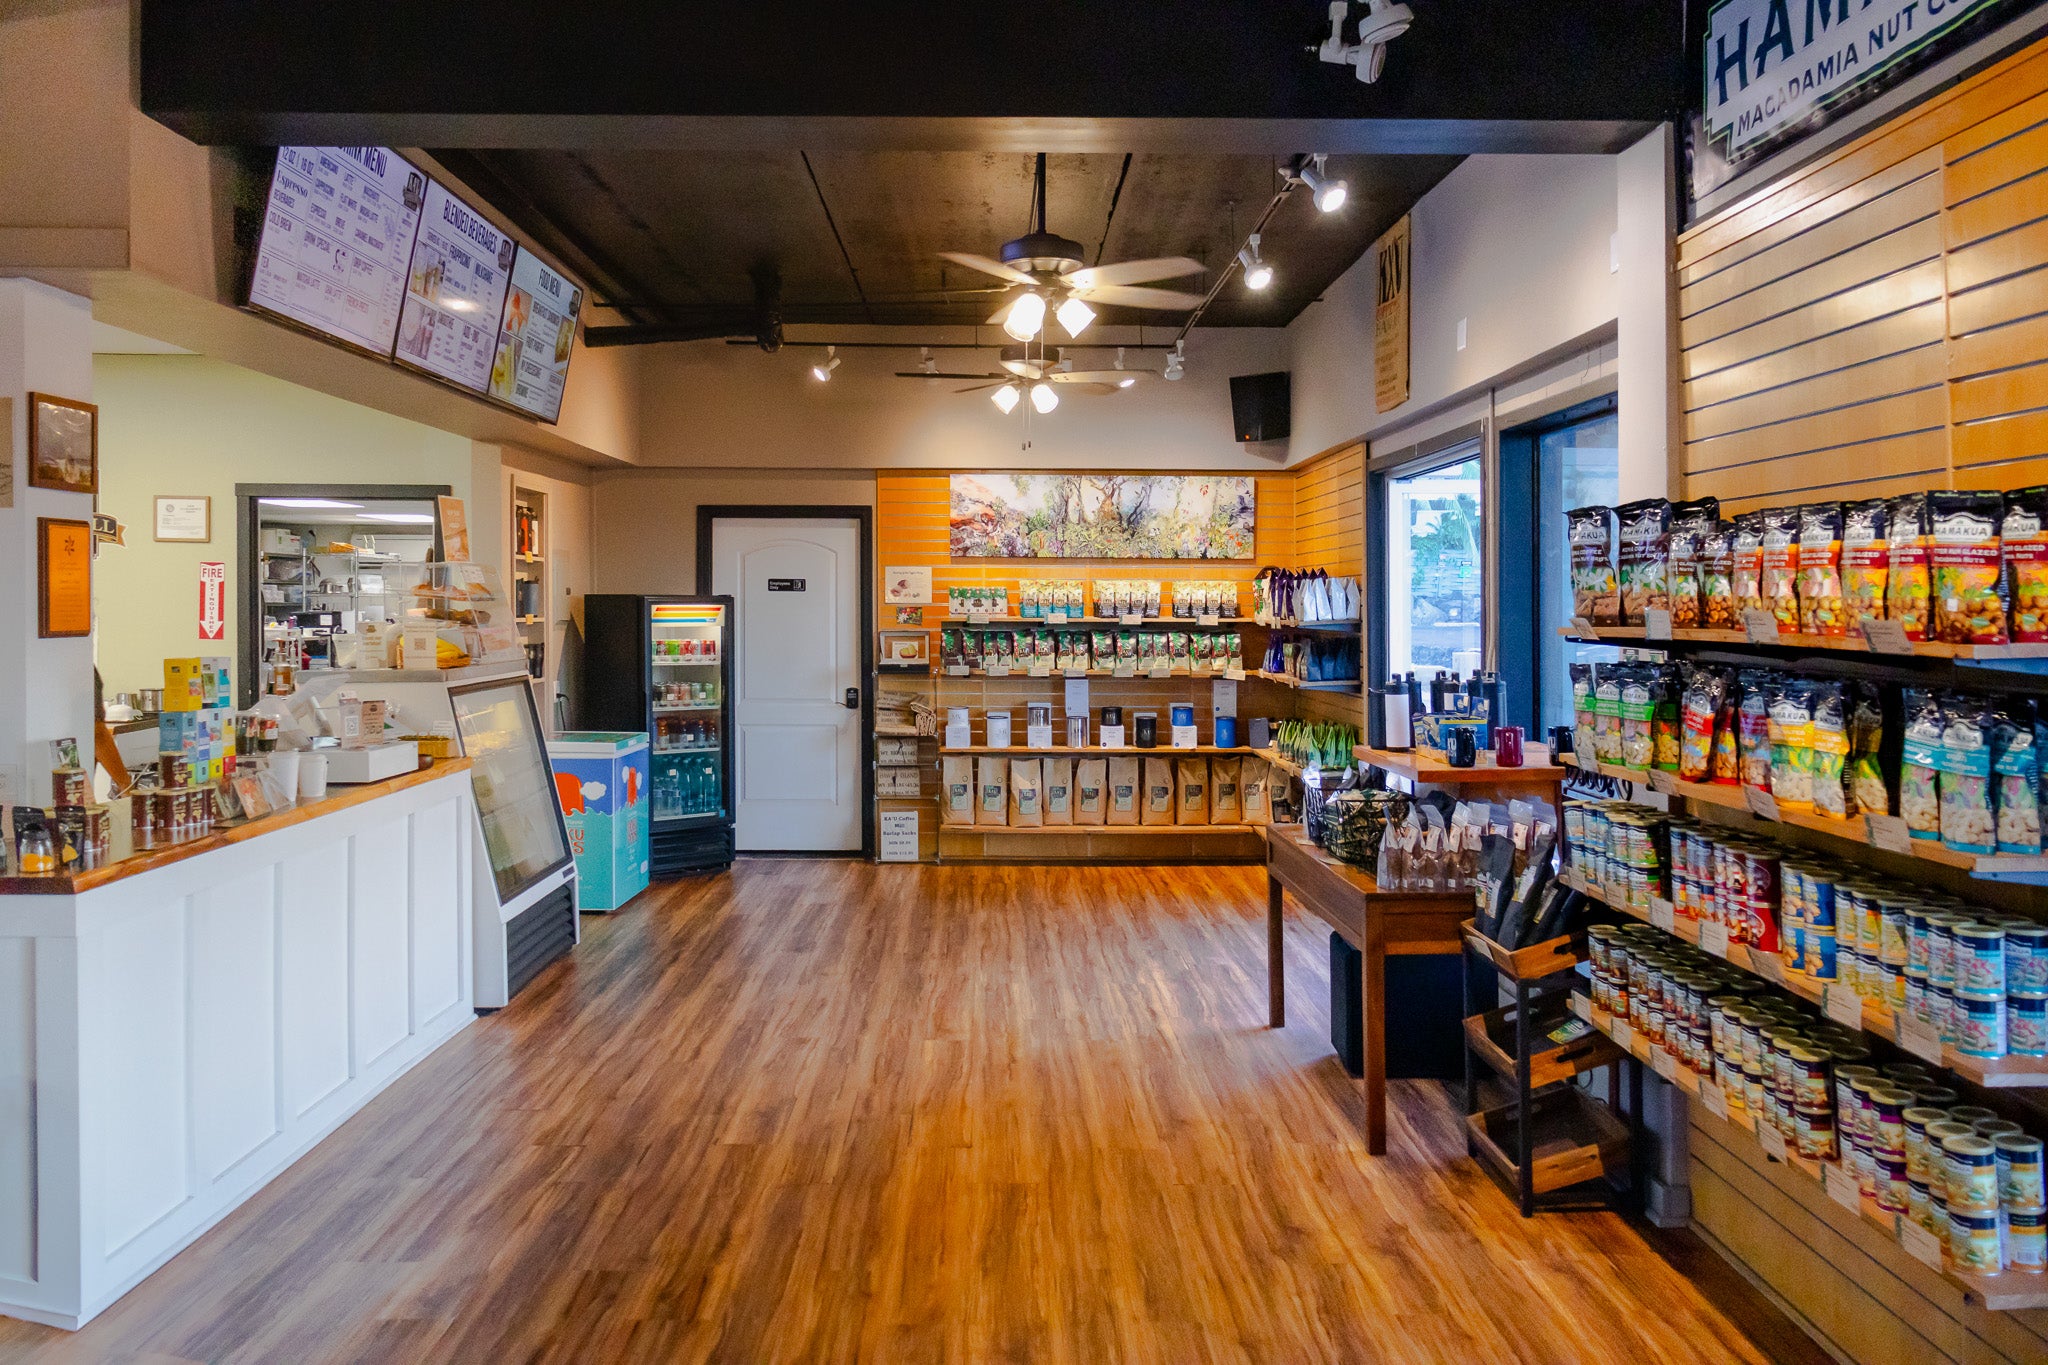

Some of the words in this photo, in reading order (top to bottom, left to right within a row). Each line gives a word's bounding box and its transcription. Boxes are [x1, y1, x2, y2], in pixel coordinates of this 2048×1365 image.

[1737, 42, 1859, 137] MACADAMIA
[1868, 1, 1919, 56] NUT
[288, 148, 295, 164] OZ
[306, 160, 314, 175] OZ
[362, 146, 388, 179] MENU
[276, 169, 309, 200] Espresso
[268, 210, 280, 226] COLD
[442, 198, 469, 234] BLENDED
[467, 217, 498, 254] BEVERAGES
[538, 268, 550, 290] FOOD
[548, 275, 561, 298] MENU
[1935, 527, 1987, 537] HAMAKUA
[202, 567, 223, 578] FIRE
